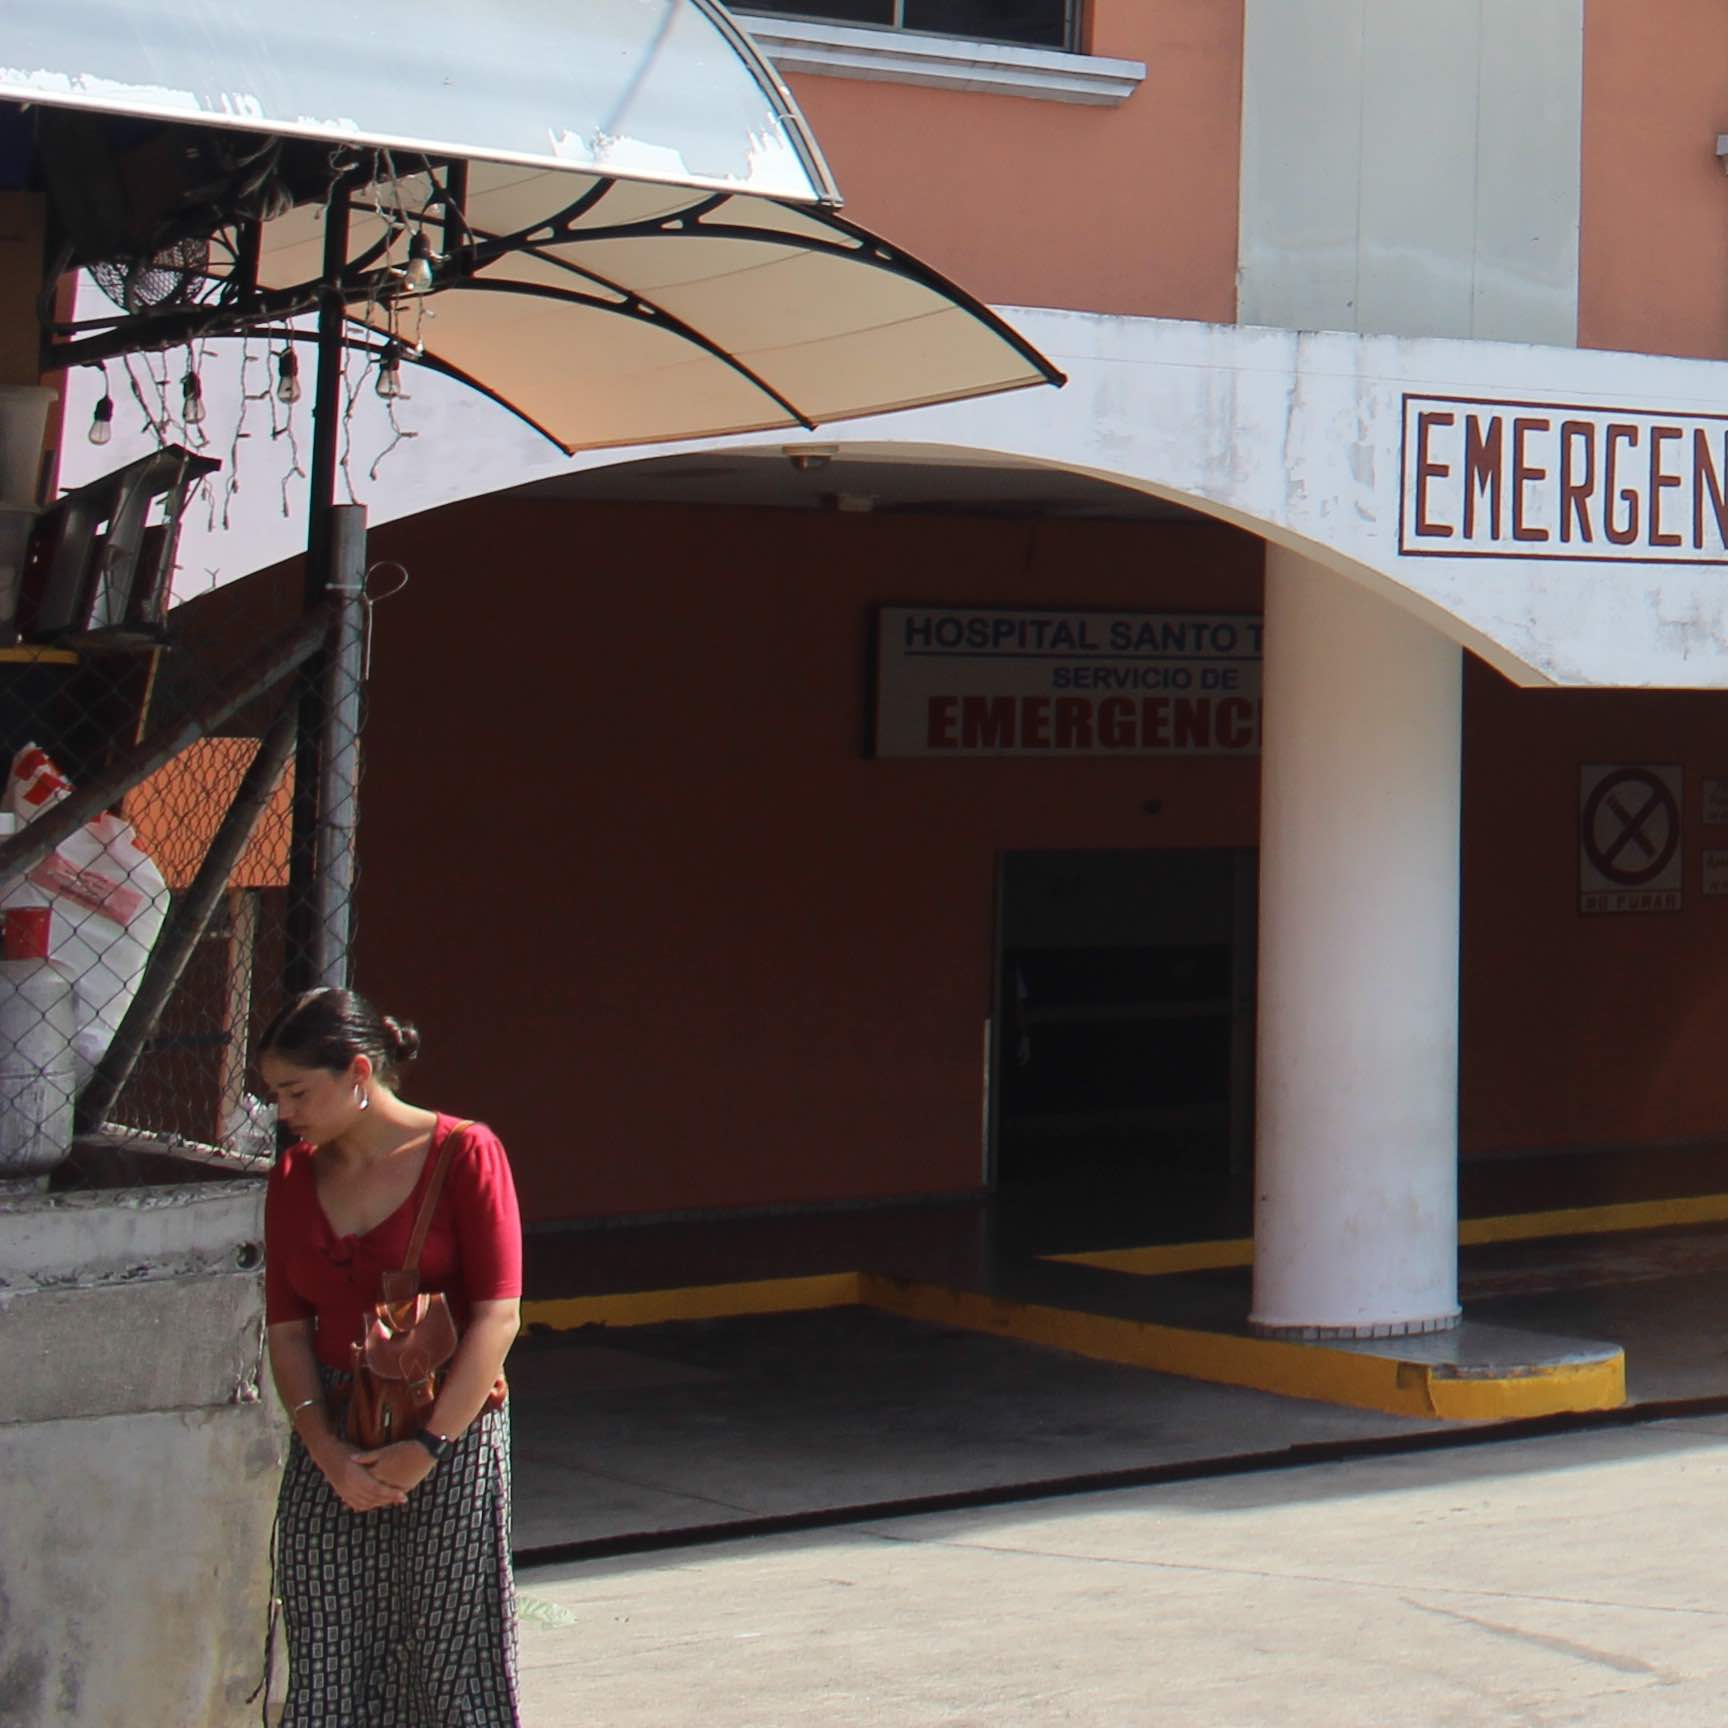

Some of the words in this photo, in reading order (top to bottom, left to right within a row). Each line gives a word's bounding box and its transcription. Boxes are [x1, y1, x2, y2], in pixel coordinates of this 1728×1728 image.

[904, 615, 1099, 649] HOSPITAL
[1109, 620, 1238, 652] SANTO
[1051, 666, 1193, 690] SERVICIO
[1200, 668, 1240, 690] DE
